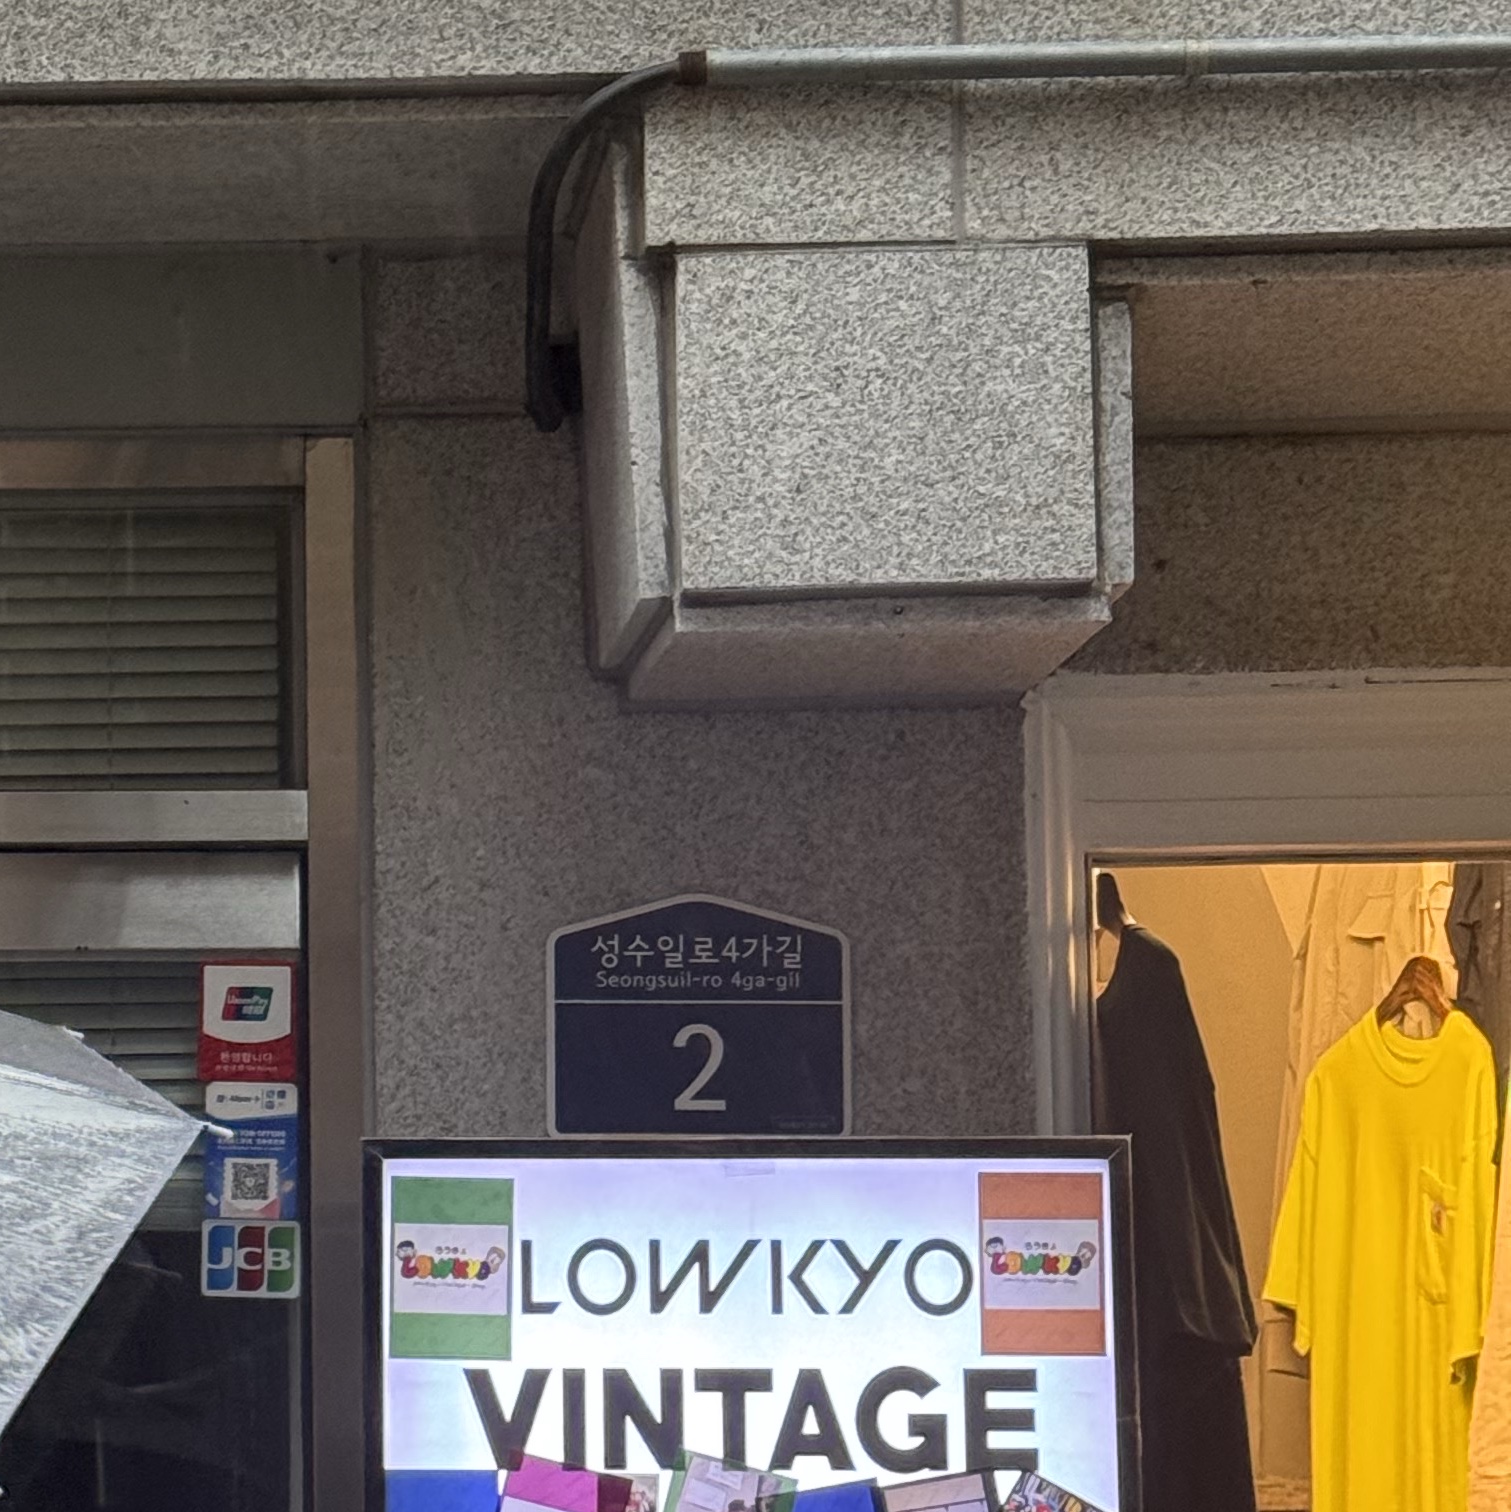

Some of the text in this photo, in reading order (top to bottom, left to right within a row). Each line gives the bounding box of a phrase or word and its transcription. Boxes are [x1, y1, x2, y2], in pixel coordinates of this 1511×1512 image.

[590, 933, 803, 969] 성수일로4가길
[595, 970, 801, 992] Seongsuil-ro 4ga-gil
[670, 1022, 728, 1113] 2
[205, 1246, 292, 1271] JCB
[520, 1237, 975, 1316] LOWKYO
[462, 1365, 1039, 1473] VINTAGE
